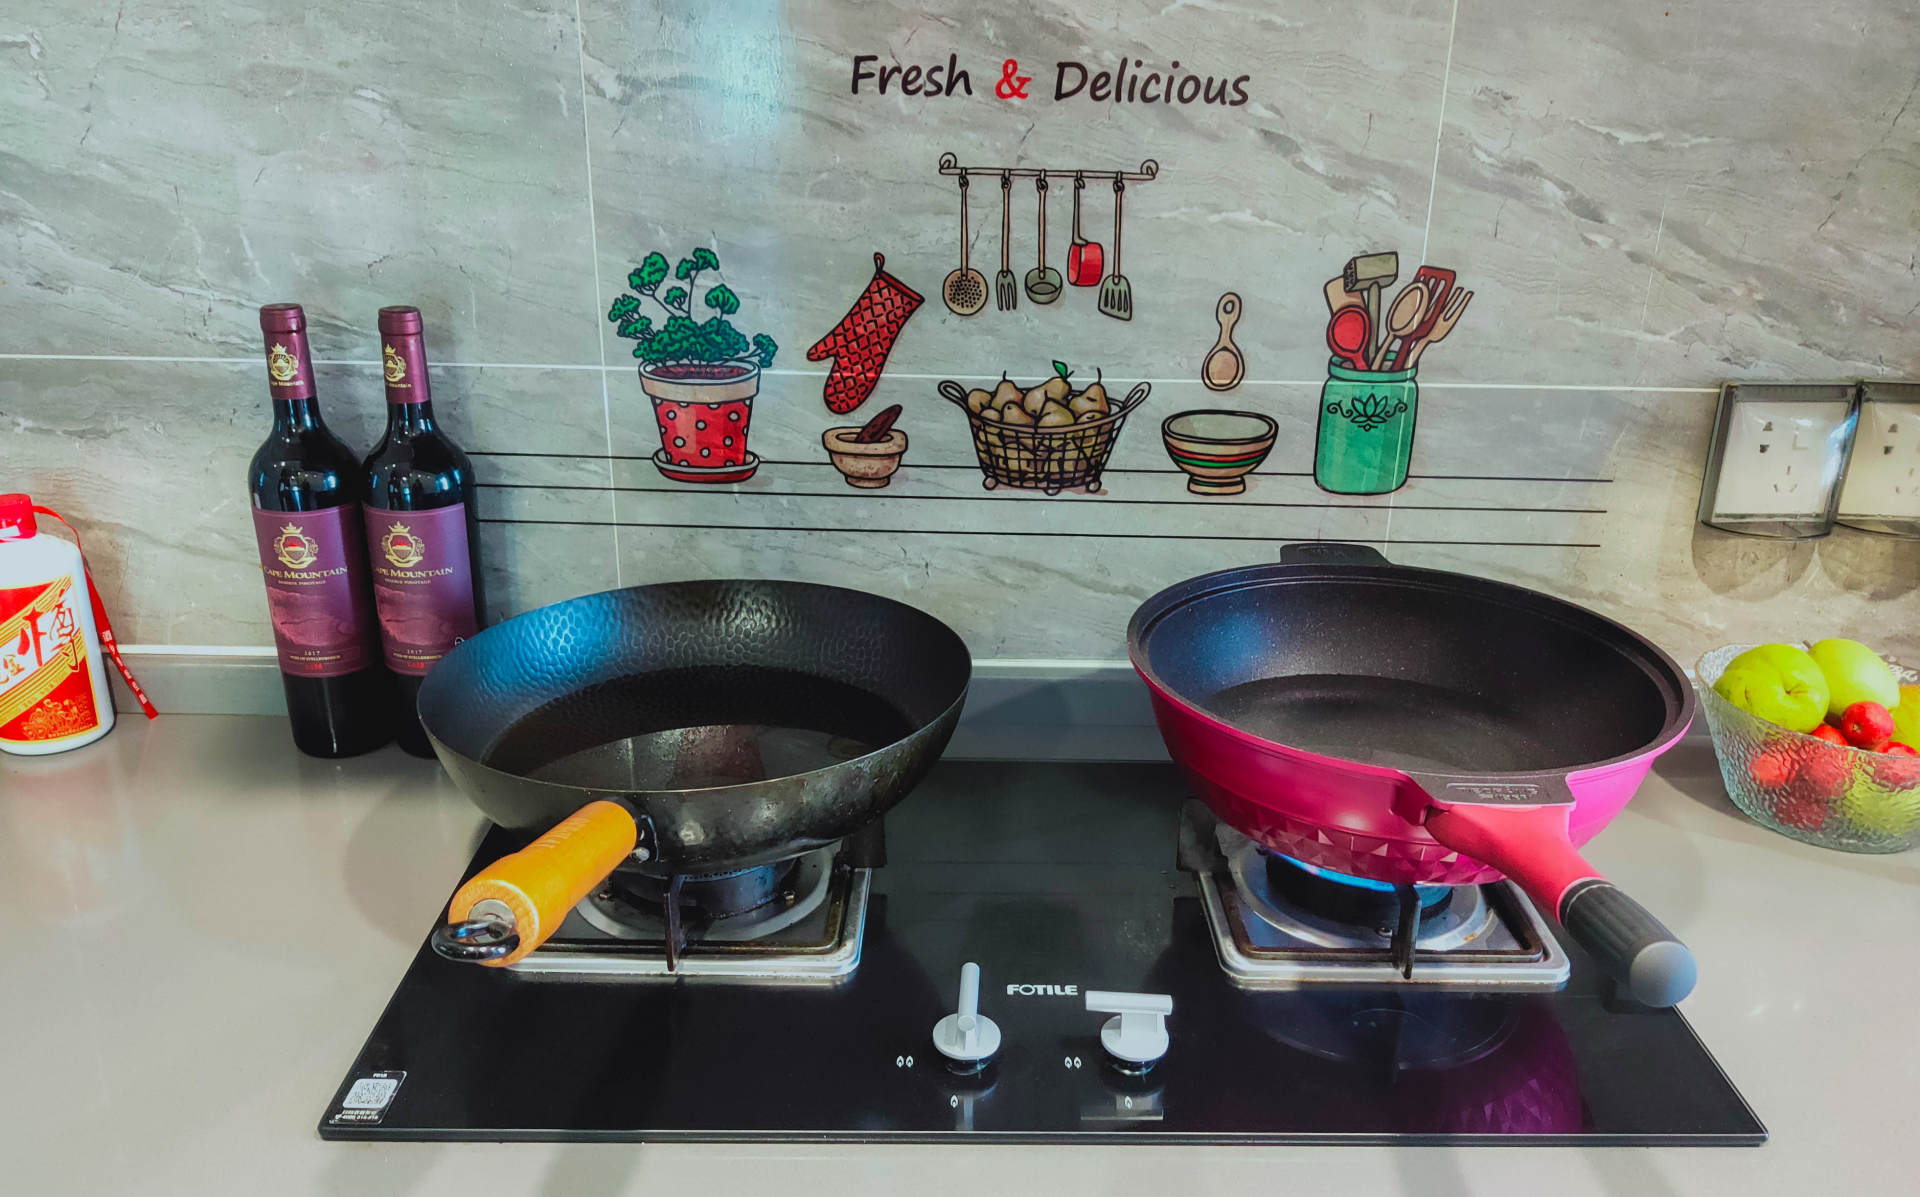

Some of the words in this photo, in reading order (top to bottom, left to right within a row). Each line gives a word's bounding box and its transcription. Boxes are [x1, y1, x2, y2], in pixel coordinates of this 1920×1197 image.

[851, 53, 973, 98] Fresh
[994, 58, 1032, 100] &
[1053, 57, 1251, 106] Delicious
[284, 566, 348, 579] MOUNTAIN
[390, 567, 454, 578] MOUNTAIN
[0, 588, 81, 684] 金樽
[1006, 984, 1079, 996] FOTILE
